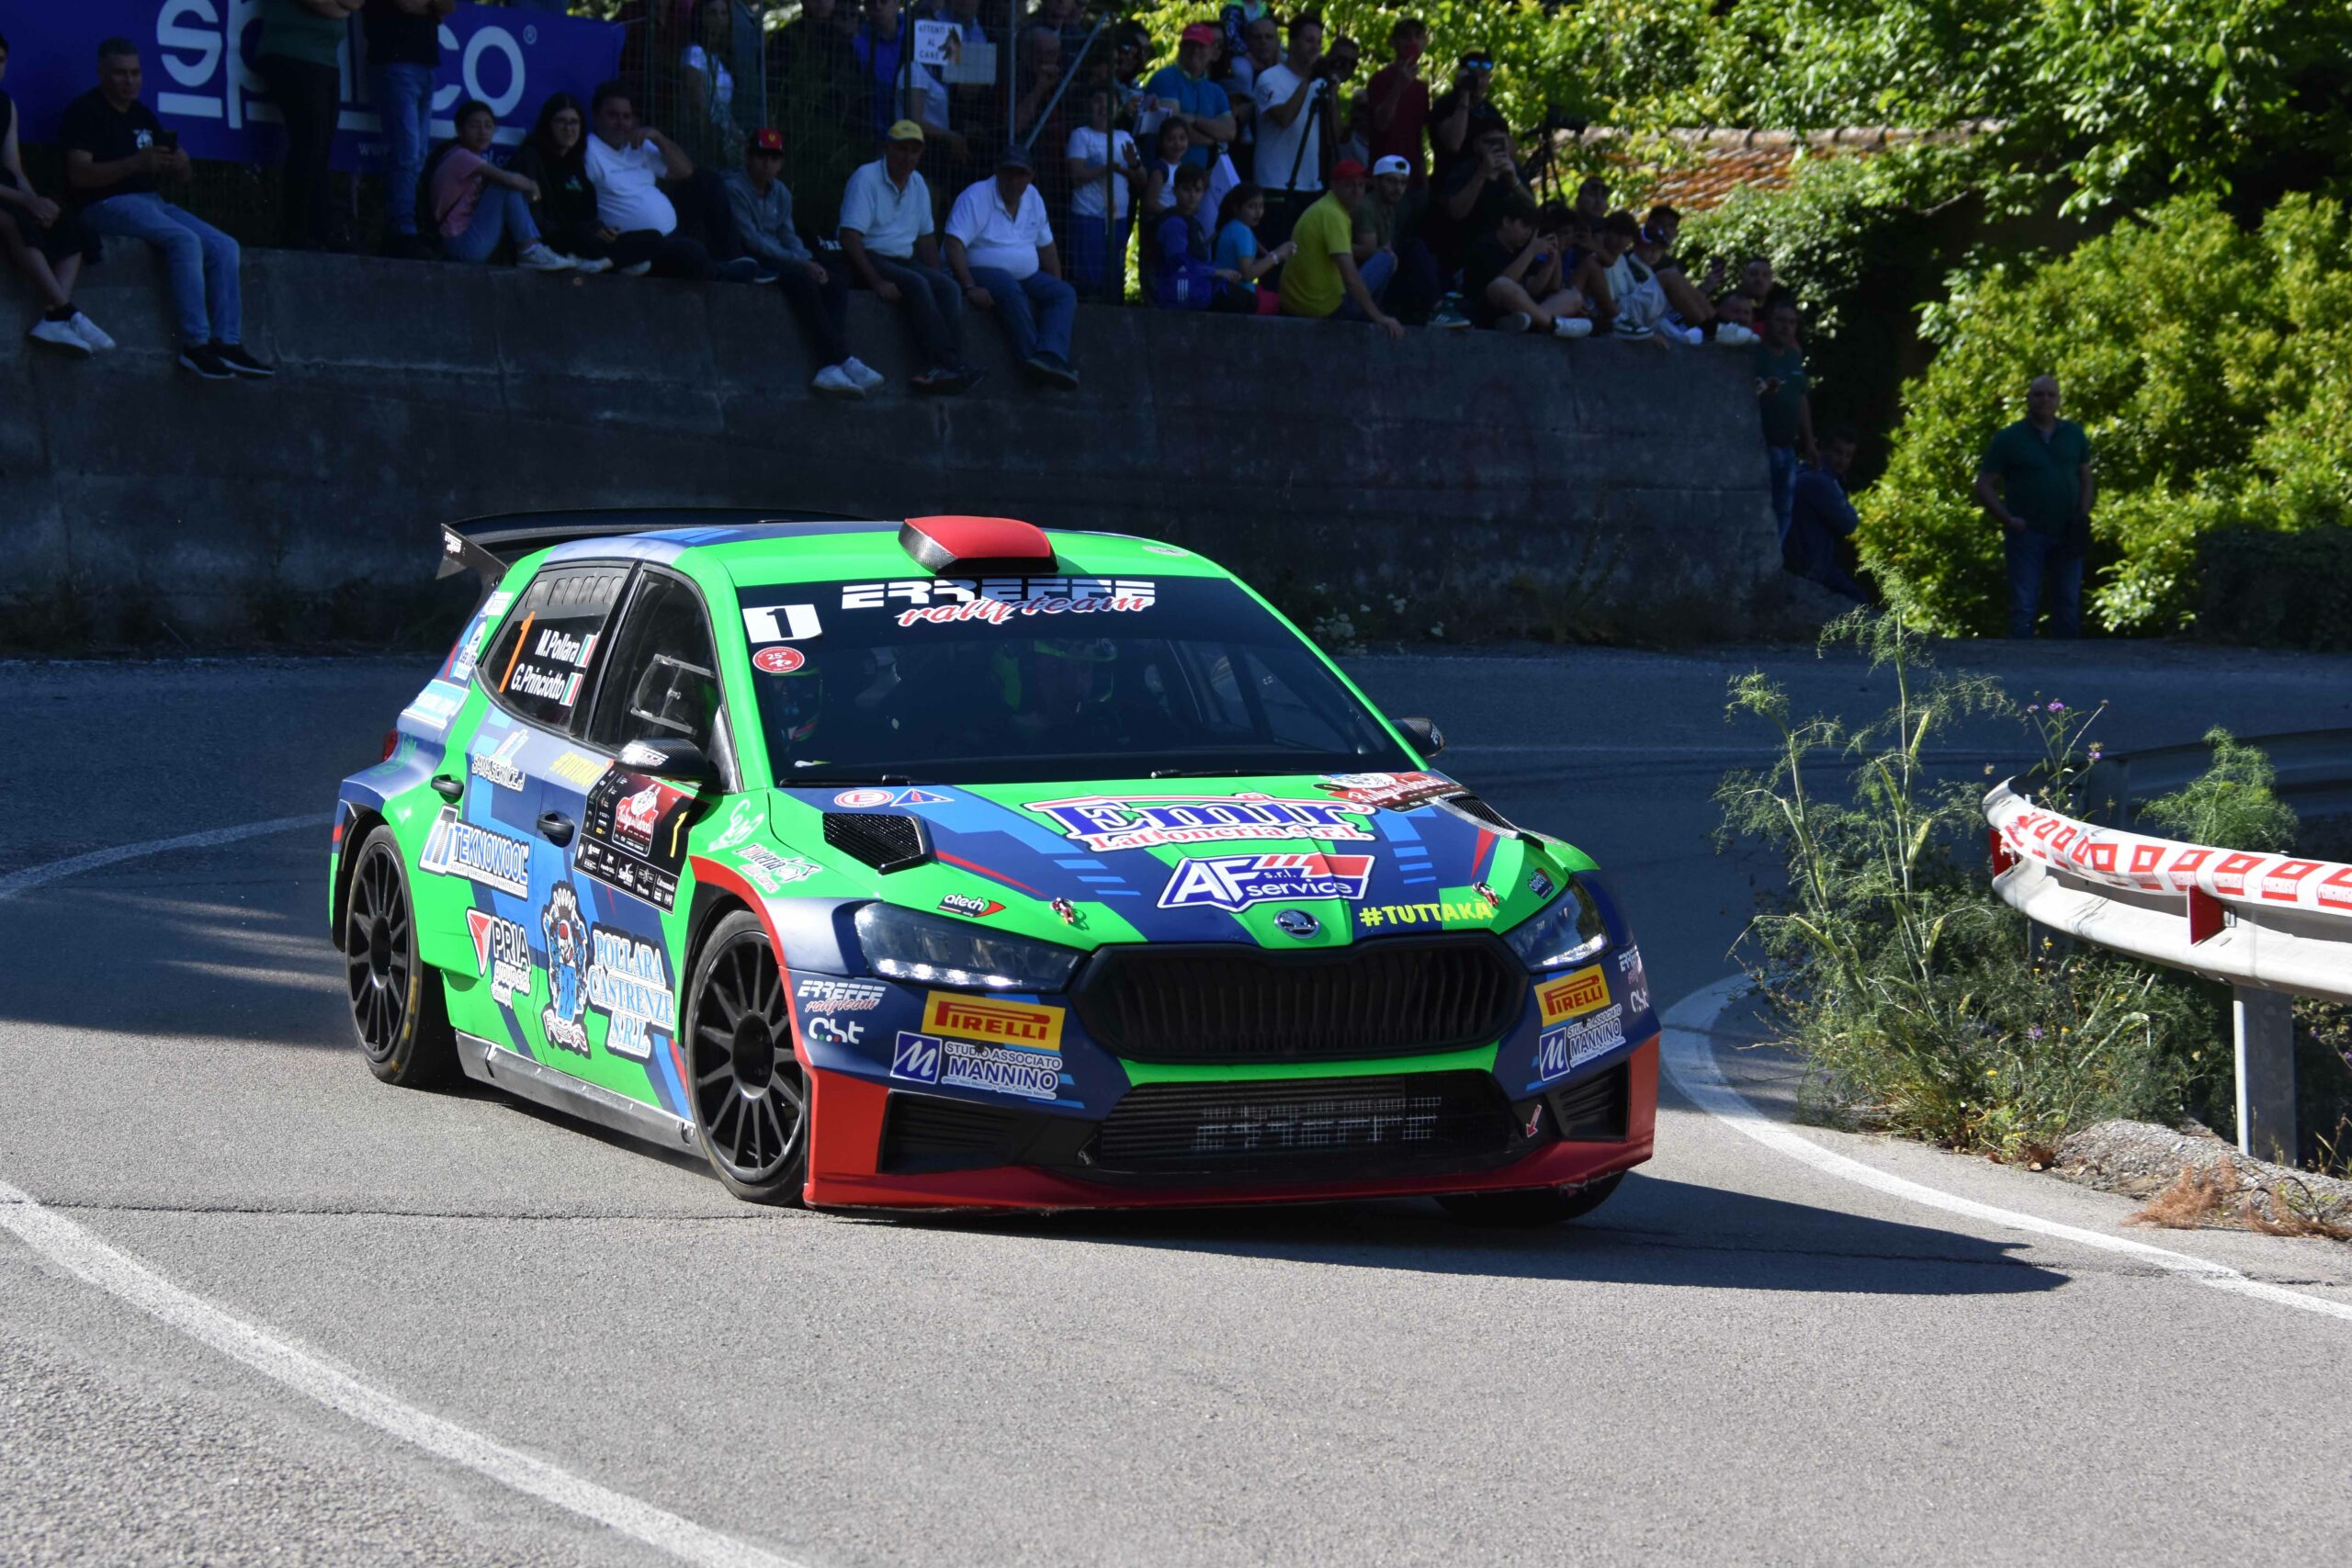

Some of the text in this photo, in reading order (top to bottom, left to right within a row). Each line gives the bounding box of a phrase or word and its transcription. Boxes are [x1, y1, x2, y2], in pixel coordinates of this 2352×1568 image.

[842, 578, 1155, 610] ERREFFE
[766, 607, 794, 638] 1
[498, 611, 536, 694] 1
[535, 628, 581, 663] M.Pollara
[511, 663, 566, 701] G.Princiotto
[670, 809, 691, 858] 1
[455, 825, 528, 884] TEKNOWOOL
[1249, 878, 1353, 897] service
[1264, 868, 1296, 879] s.r.l.
[944, 894, 984, 911] atech
[493, 919, 530, 968] PRIA
[595, 935, 665, 986] POLLARA
[589, 968, 673, 1025] CASTRENZE
[797, 980, 886, 1007] ERREFFE
[1544, 974, 1604, 1017] PIRELLI
[609, 1012, 649, 1051] S.R.L.
[934, 1001, 1051, 1041] PIRELLI
[1572, 1020, 1622, 1057] MANNINO
[949, 1057, 1057, 1090] MANNINO
[992, 1050, 1061, 1068] ASSOCIATO
